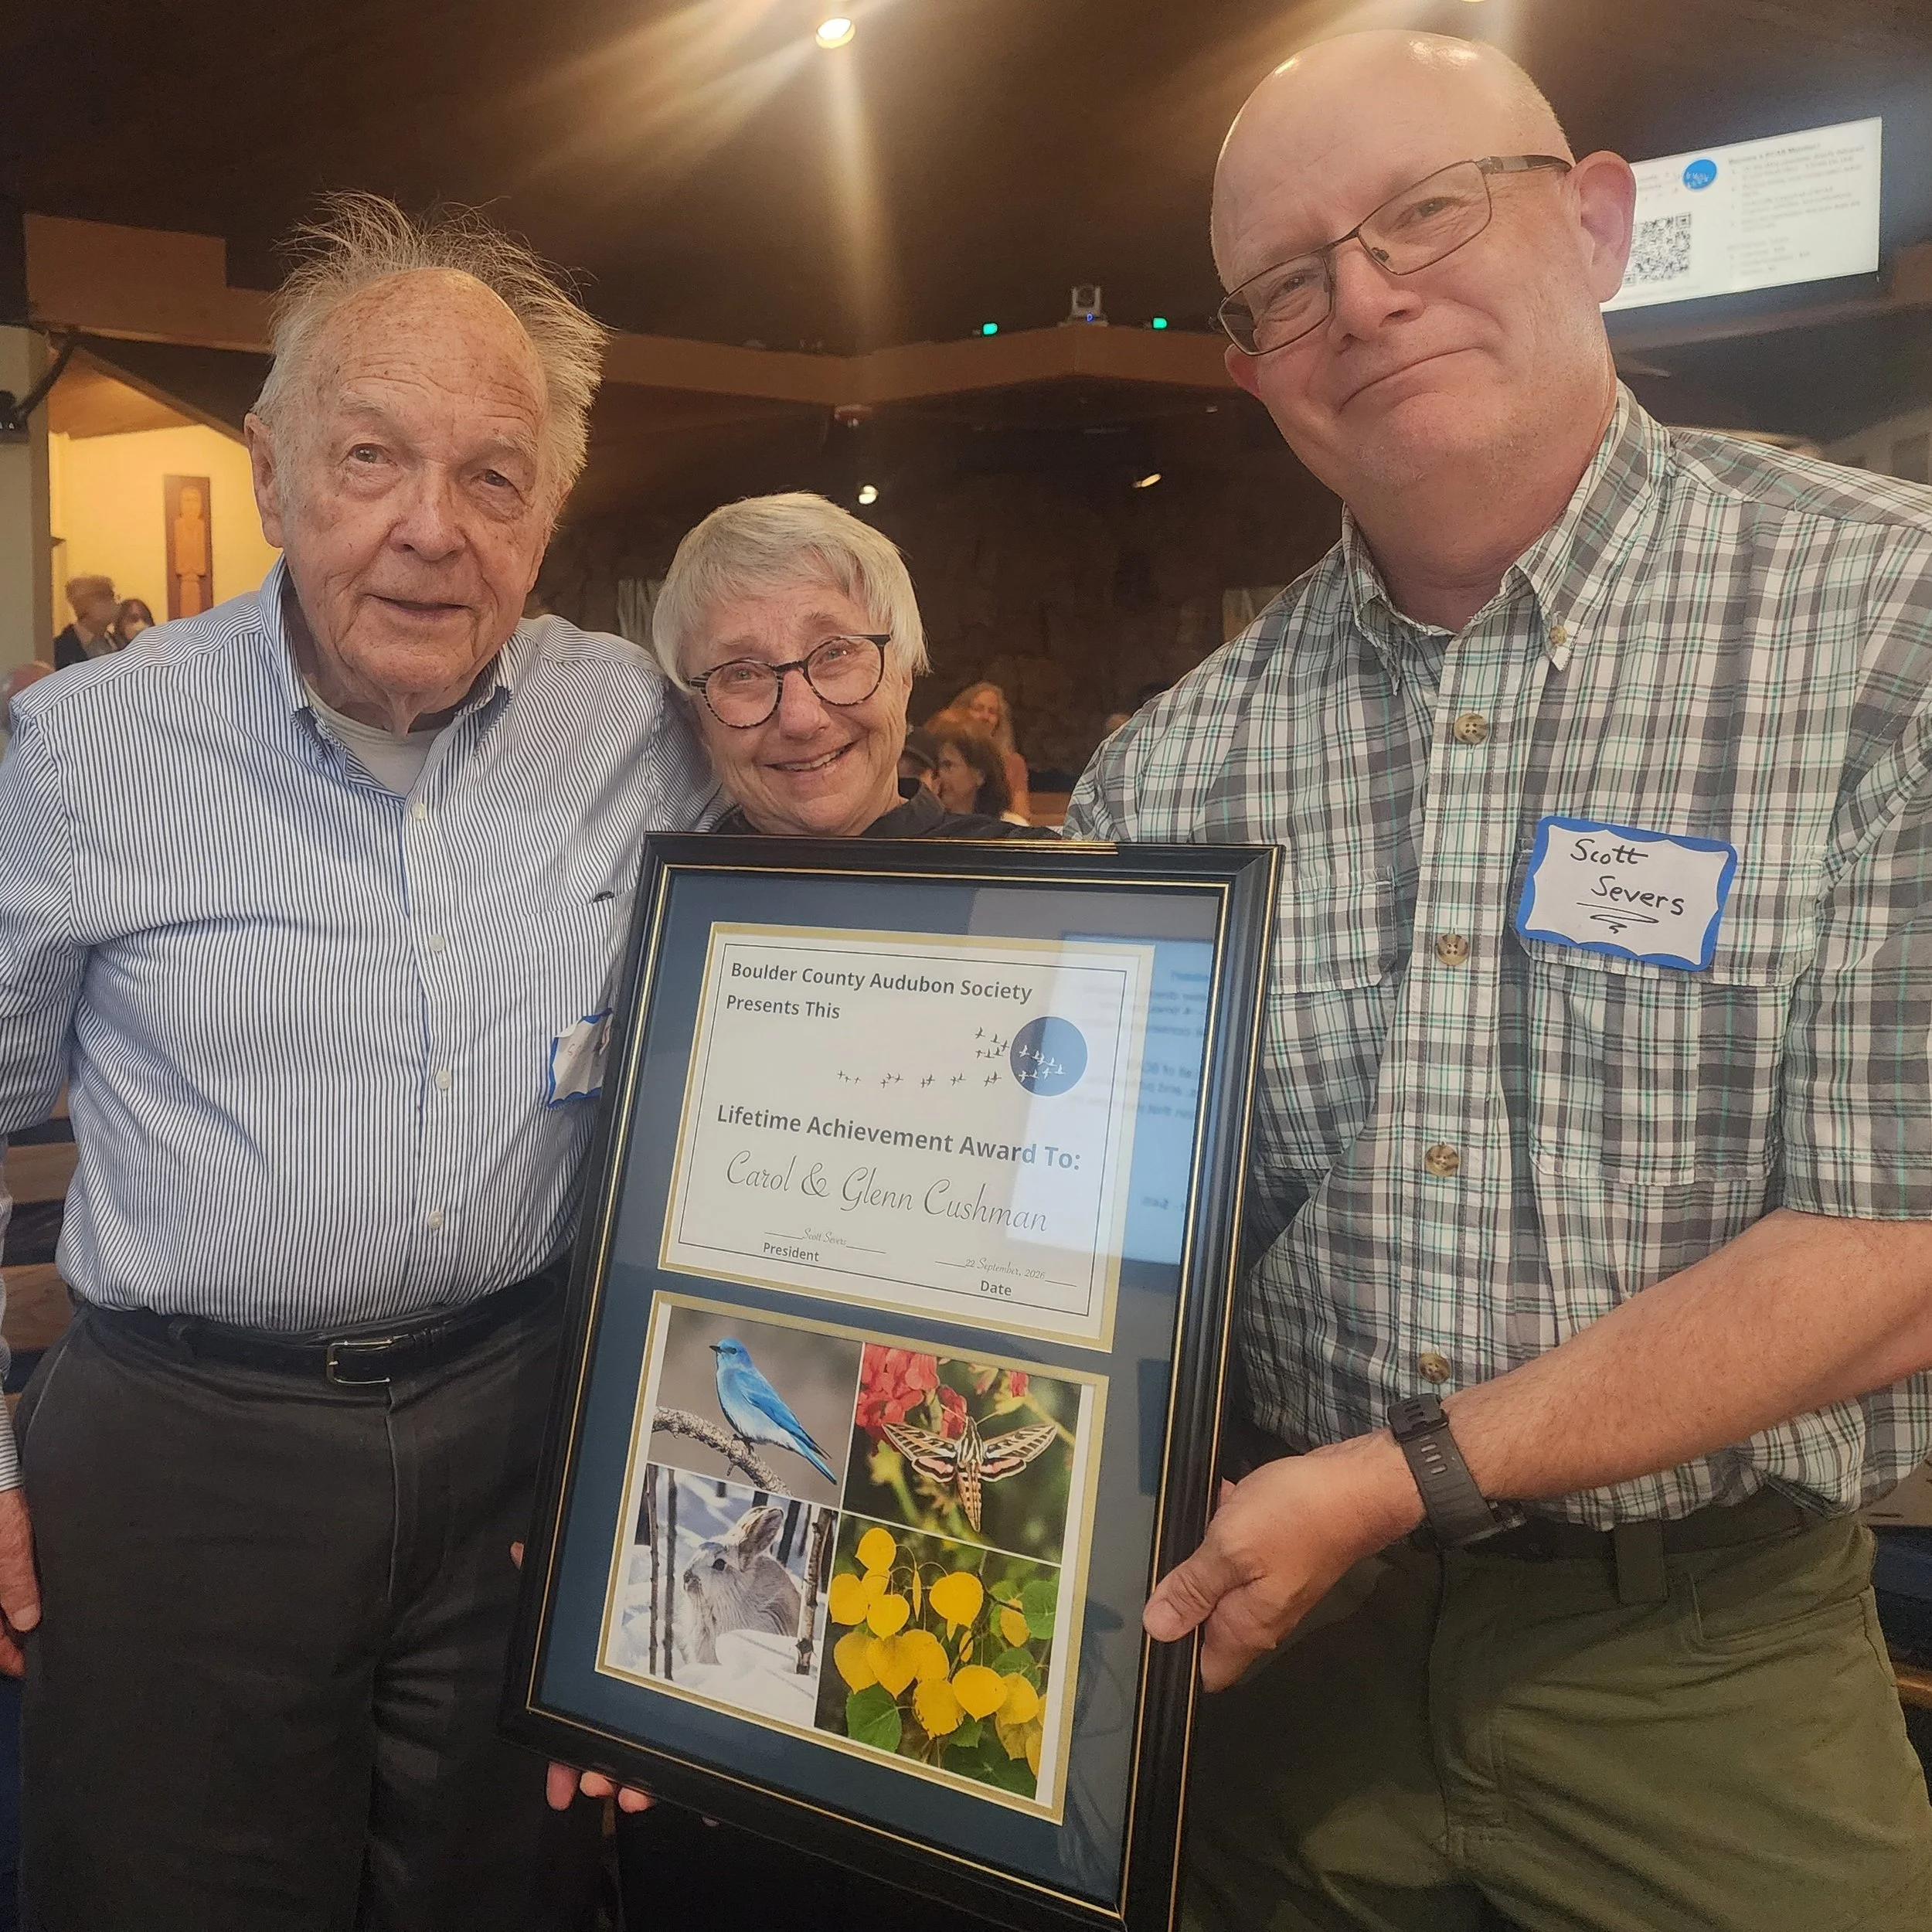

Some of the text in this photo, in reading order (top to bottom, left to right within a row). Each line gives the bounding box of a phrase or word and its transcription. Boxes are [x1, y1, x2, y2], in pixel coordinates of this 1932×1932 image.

[1570, 838, 1648, 865] Scott
[1590, 876, 1685, 916] Severs
[731, 962, 1032, 1005] Boulder County Audubon Society
[726, 995, 841, 1019] Presents This
[717, 1104, 1080, 1170] Lifetime Achievement Award To:
[726, 1150, 1047, 1232] Carol & Glenn Cushman
[801, 1227, 822, 1242] Scott
[763, 1242, 820, 1262] President
[965, 1259, 975, 1268] 22
[977, 1257, 1022, 1277] September,
[980, 1280, 1012, 1296] Date
